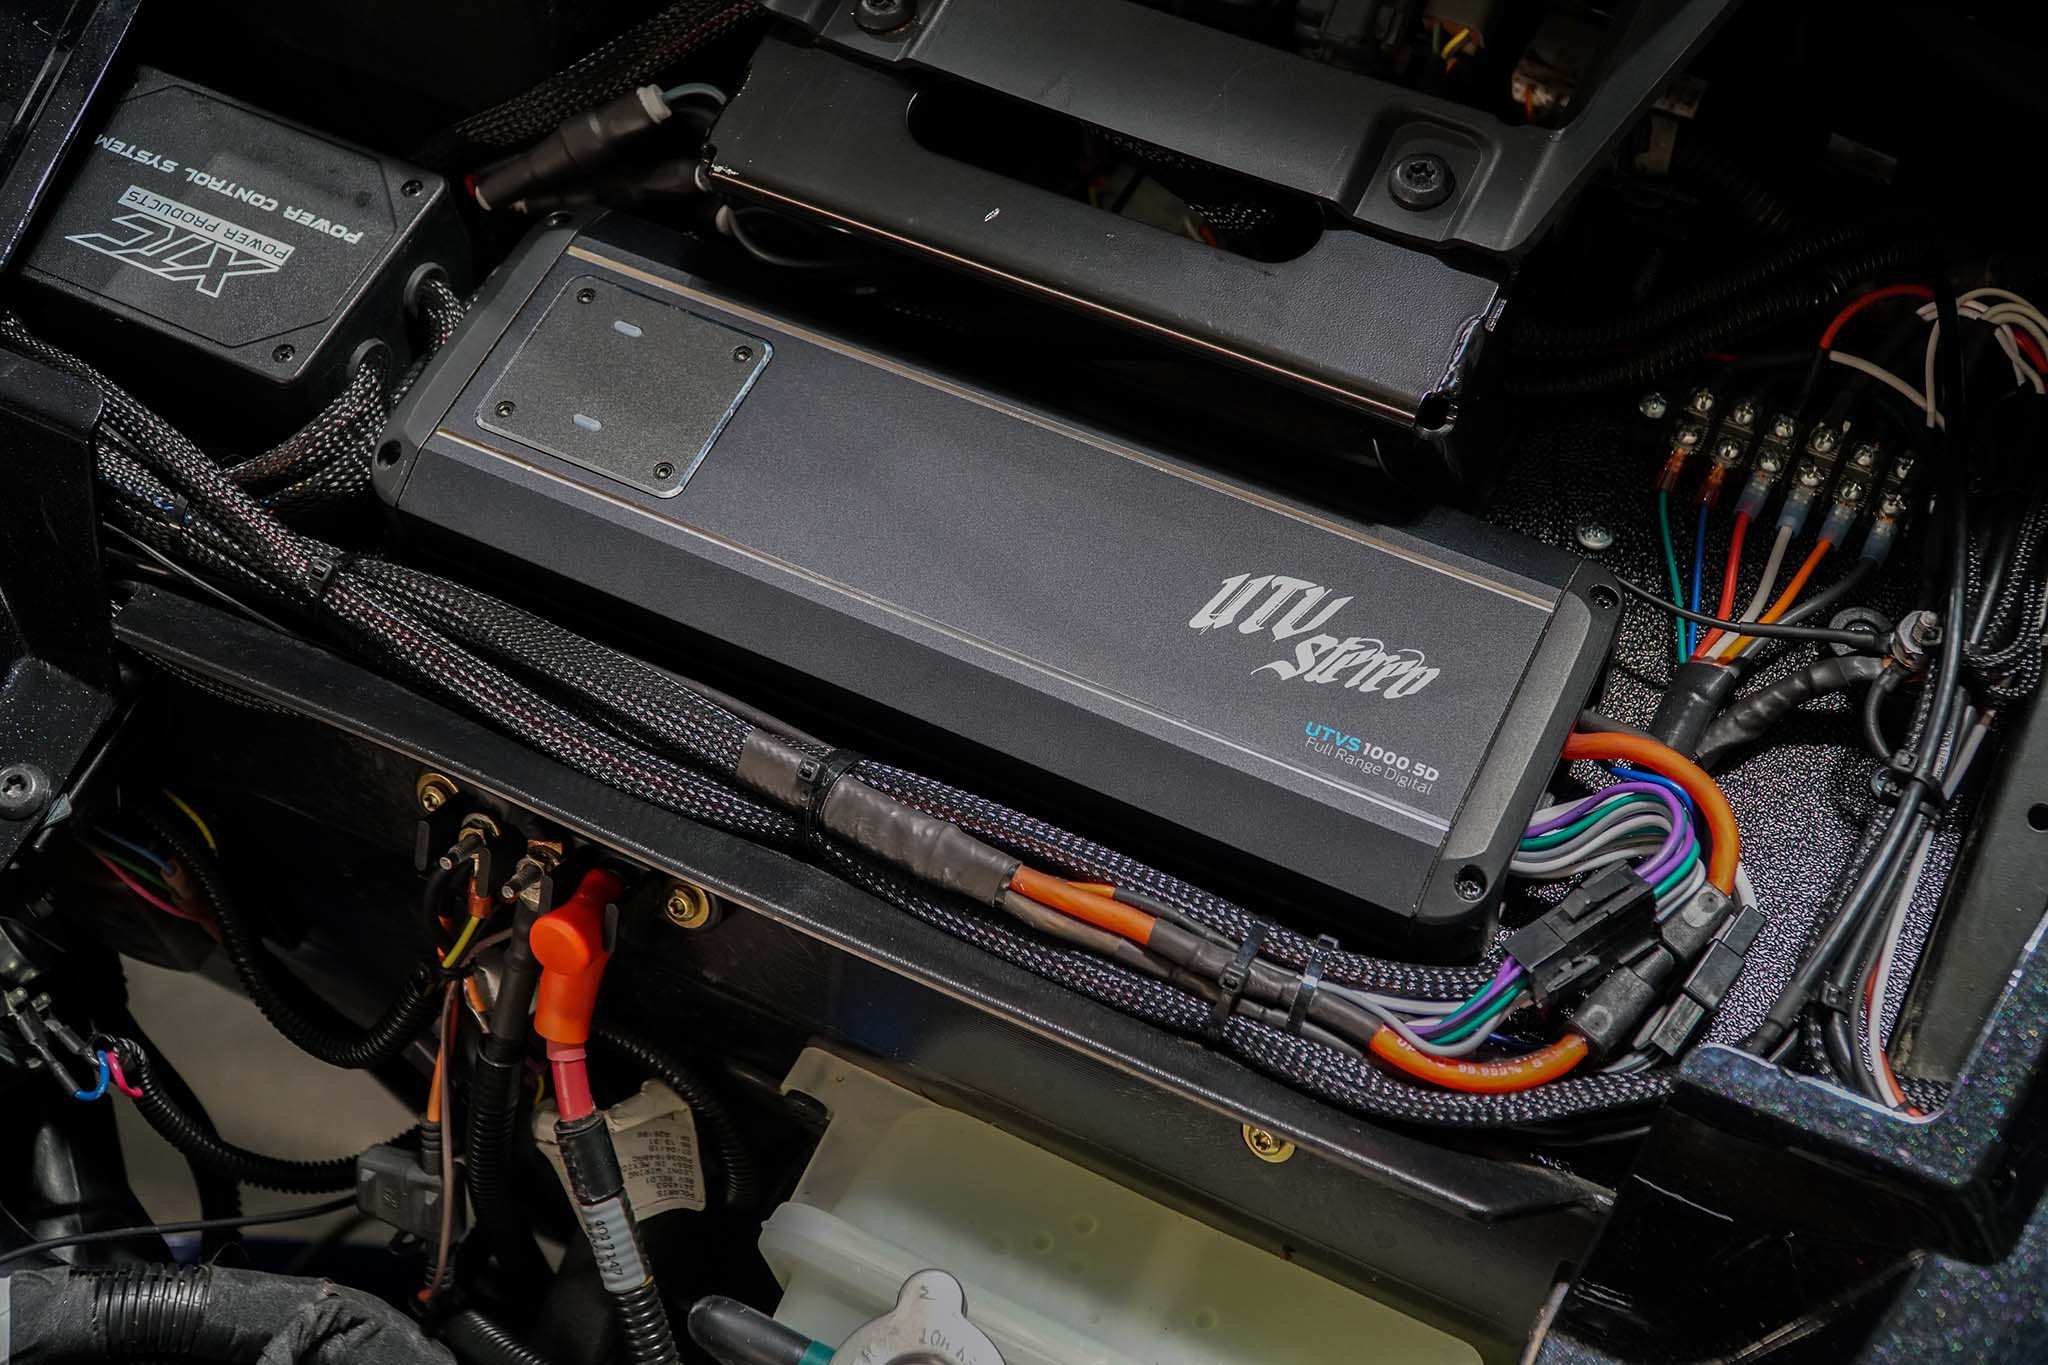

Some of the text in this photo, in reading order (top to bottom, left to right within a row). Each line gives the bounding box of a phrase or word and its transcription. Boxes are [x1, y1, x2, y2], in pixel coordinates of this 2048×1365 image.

[94, 133, 365, 245] POWER CONTROL SYSTEM
[64, 212, 281, 298] XTC
[126, 190, 289, 259] POWER PRODUCTS
[1188, 572, 1355, 642] UTV
[1250, 633, 1441, 699] Stereo
[1304, 736, 1434, 796] Full Range Digital
